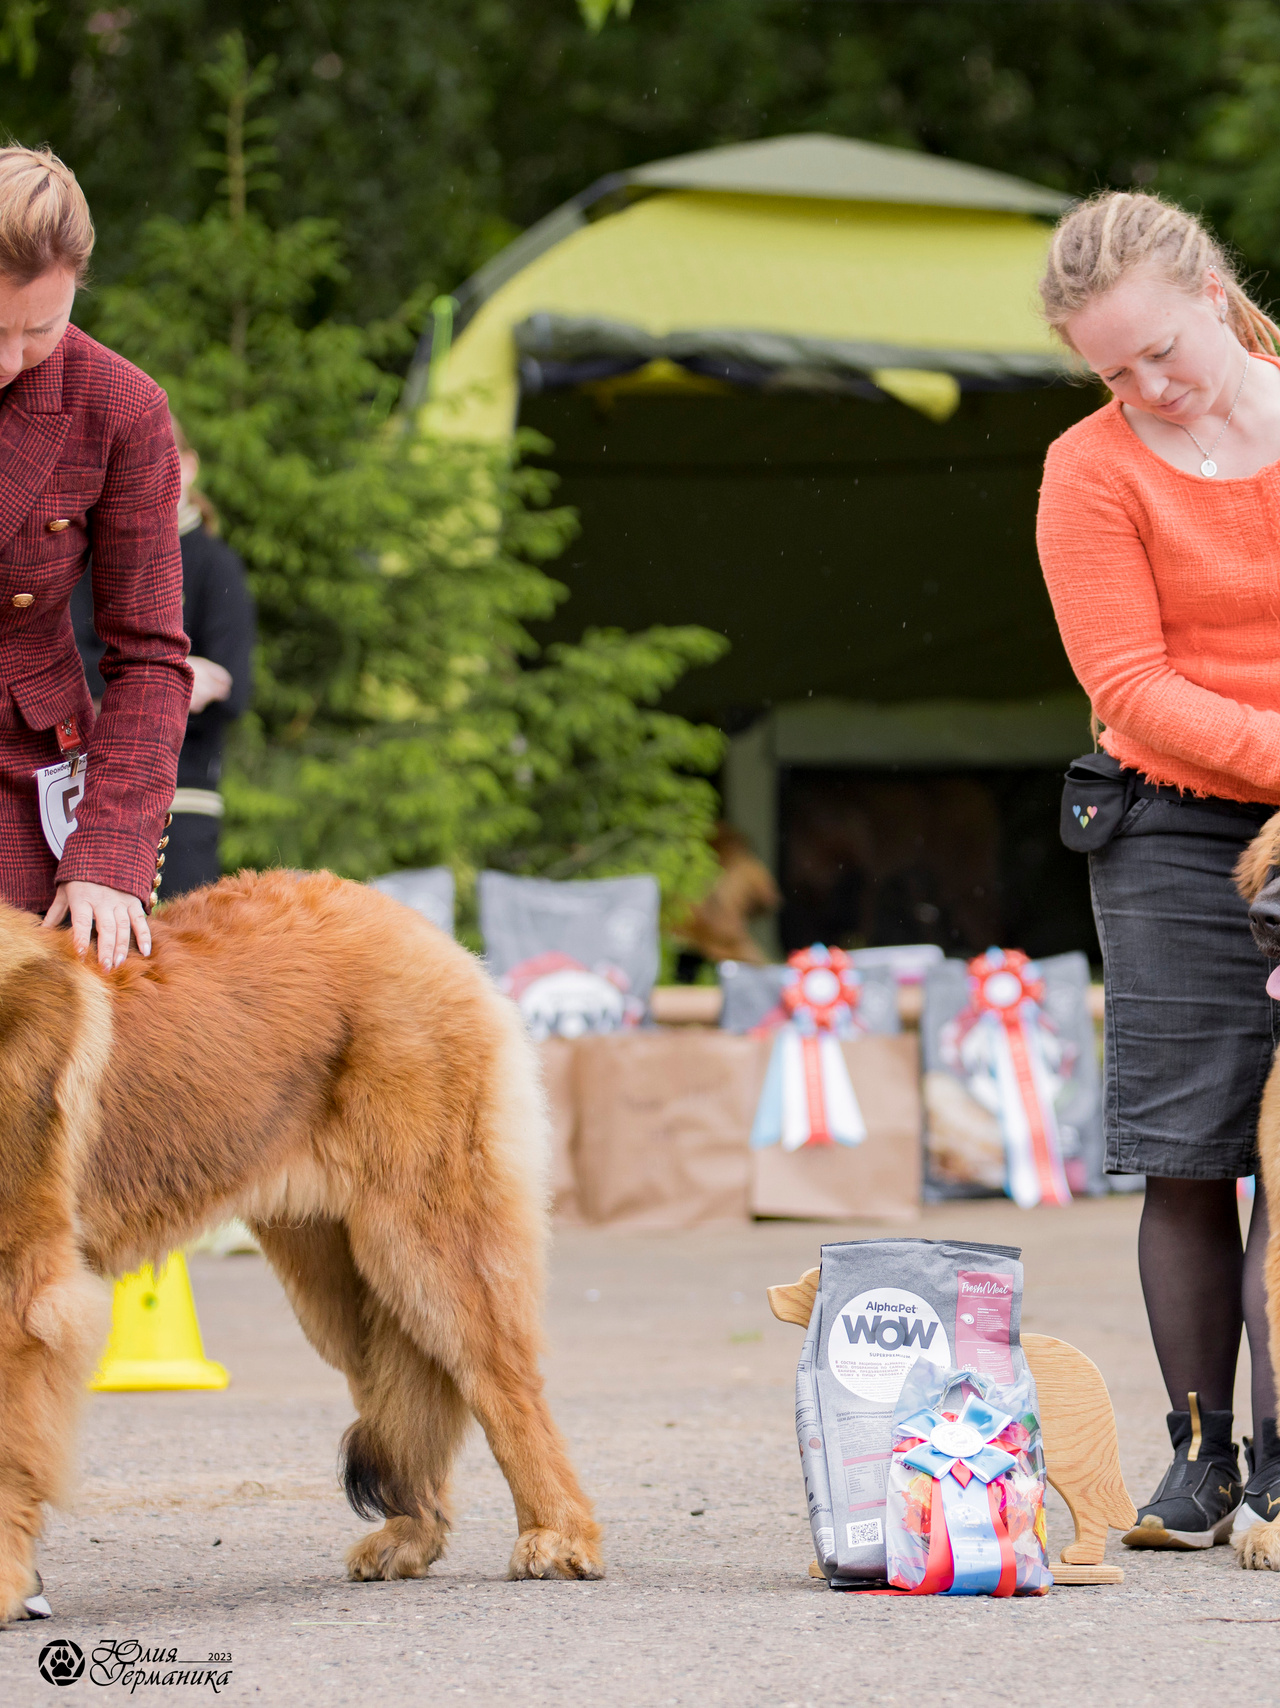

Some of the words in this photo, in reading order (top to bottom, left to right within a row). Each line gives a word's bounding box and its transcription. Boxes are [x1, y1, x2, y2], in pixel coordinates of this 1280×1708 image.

[961, 1281, 1010, 1295] FreshMeat
[865, 1301, 917, 1314] AlphaPet
[841, 1315, 939, 1351] WOW
